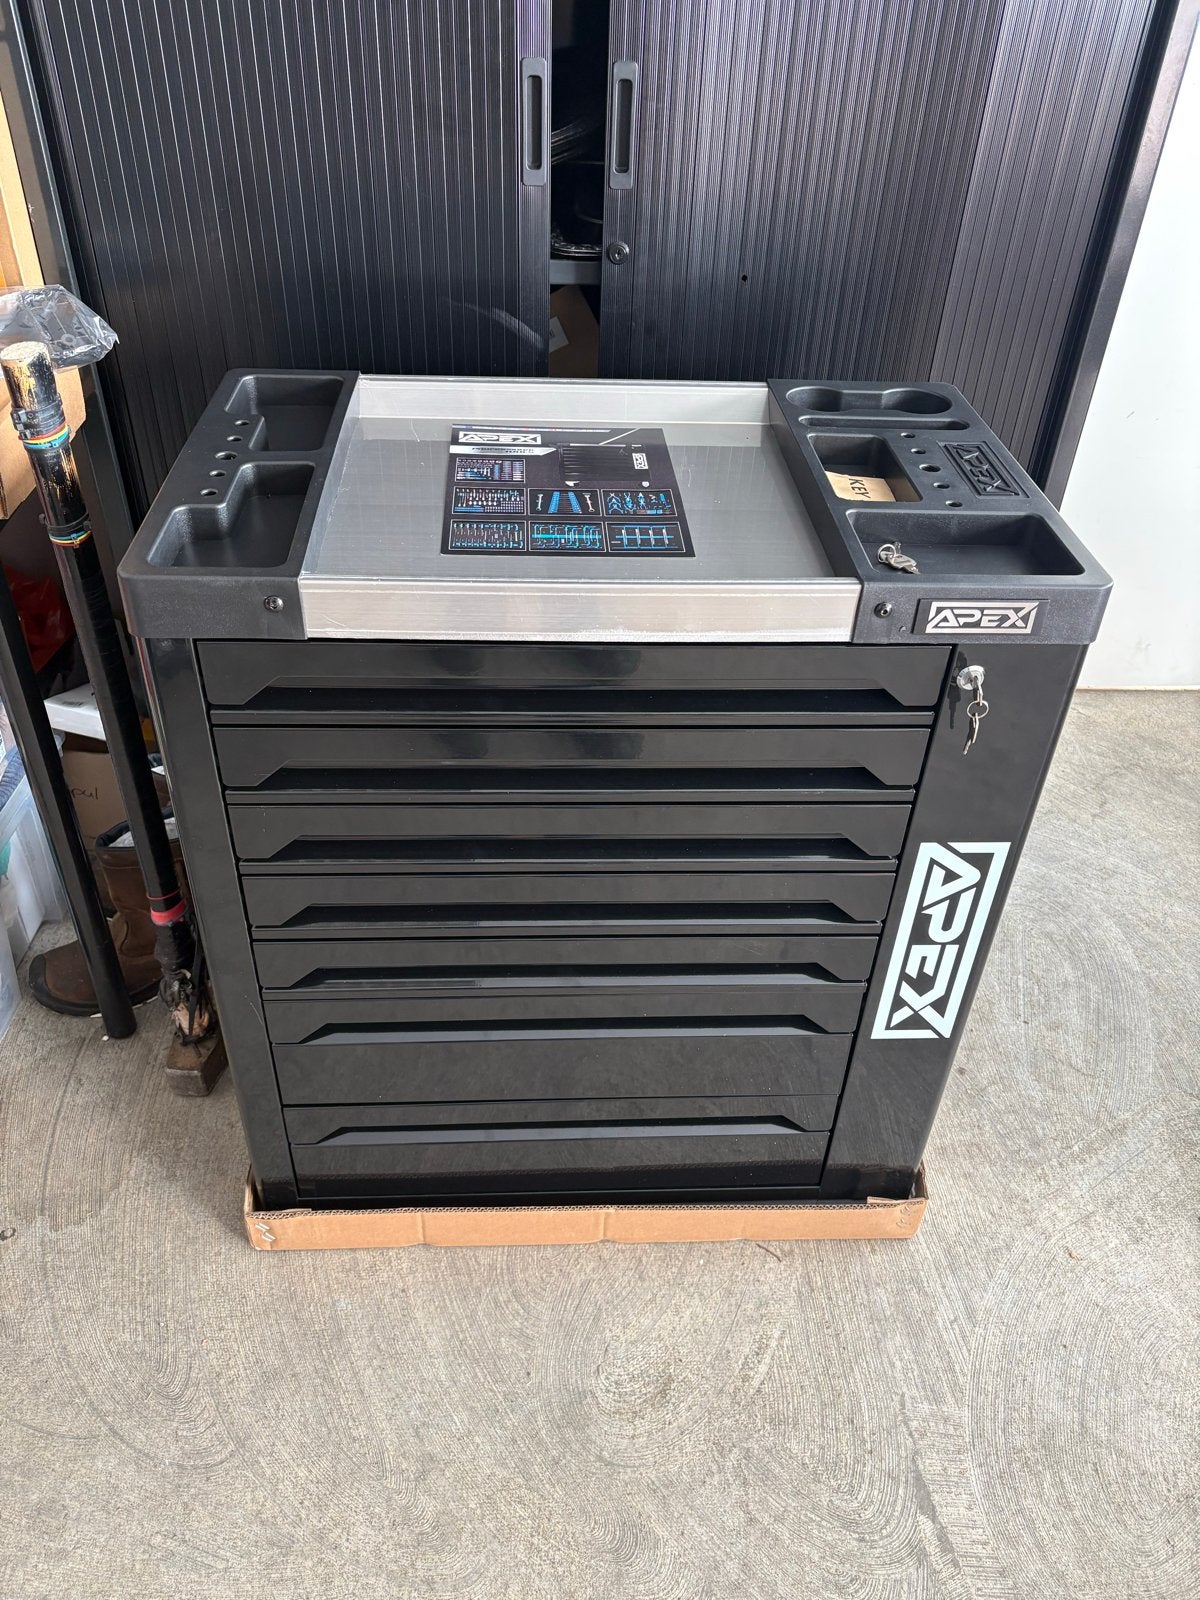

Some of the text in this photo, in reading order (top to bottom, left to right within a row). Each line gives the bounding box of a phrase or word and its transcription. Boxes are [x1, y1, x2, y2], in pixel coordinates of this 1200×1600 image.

[460, 432, 539, 443] APEX
[947, 444, 1012, 493] APEX
[848, 478, 871, 498] KEY
[930, 605, 1036, 630] APEX
[884, 843, 992, 1037] APEX
